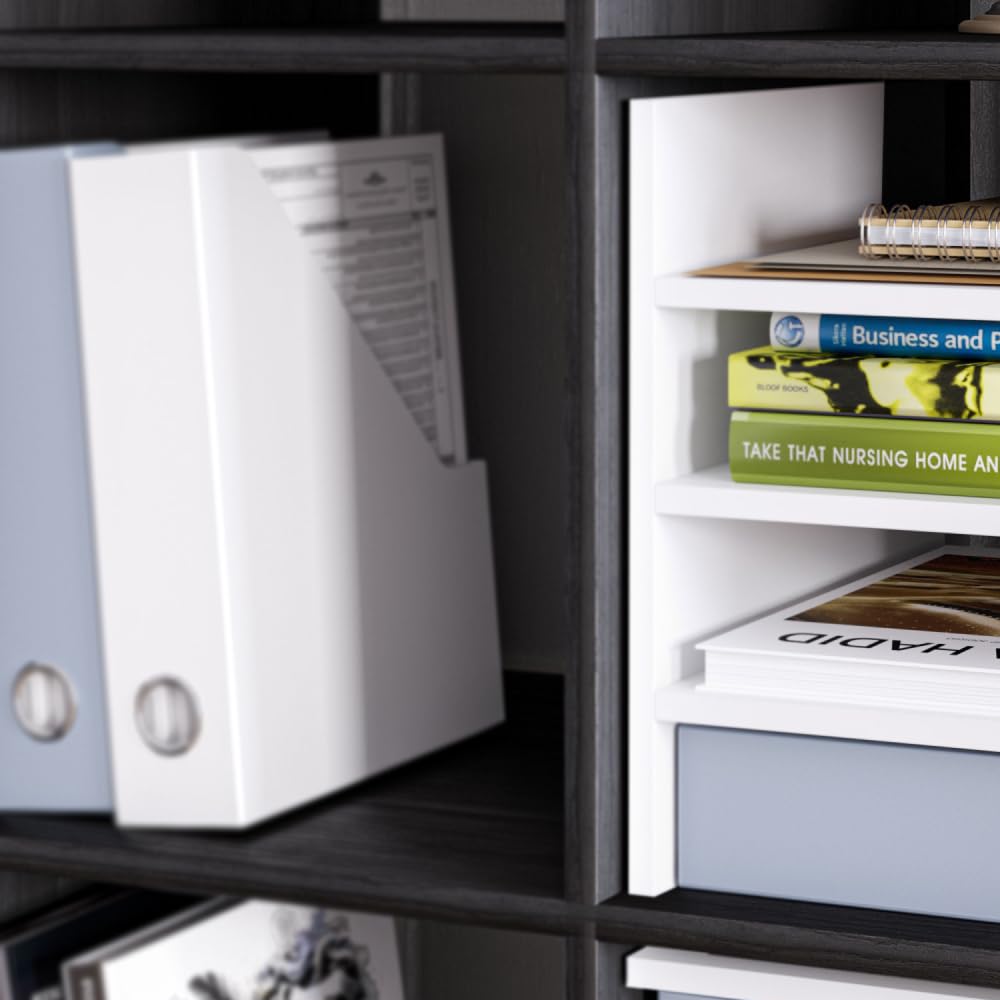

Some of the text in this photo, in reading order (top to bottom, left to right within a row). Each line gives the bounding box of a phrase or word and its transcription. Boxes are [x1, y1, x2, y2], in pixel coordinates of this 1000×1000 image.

[852, 326, 939, 348] Business
[945, 330, 983, 350] and
[782, 384, 809, 394] BOOKS
[742, 441, 781, 461] TAKE
[788, 443, 826, 463] THAT
[833, 447, 908, 469] NURSING
[915, 452, 967, 472] HOME
[778, 632, 974, 656] HADID
